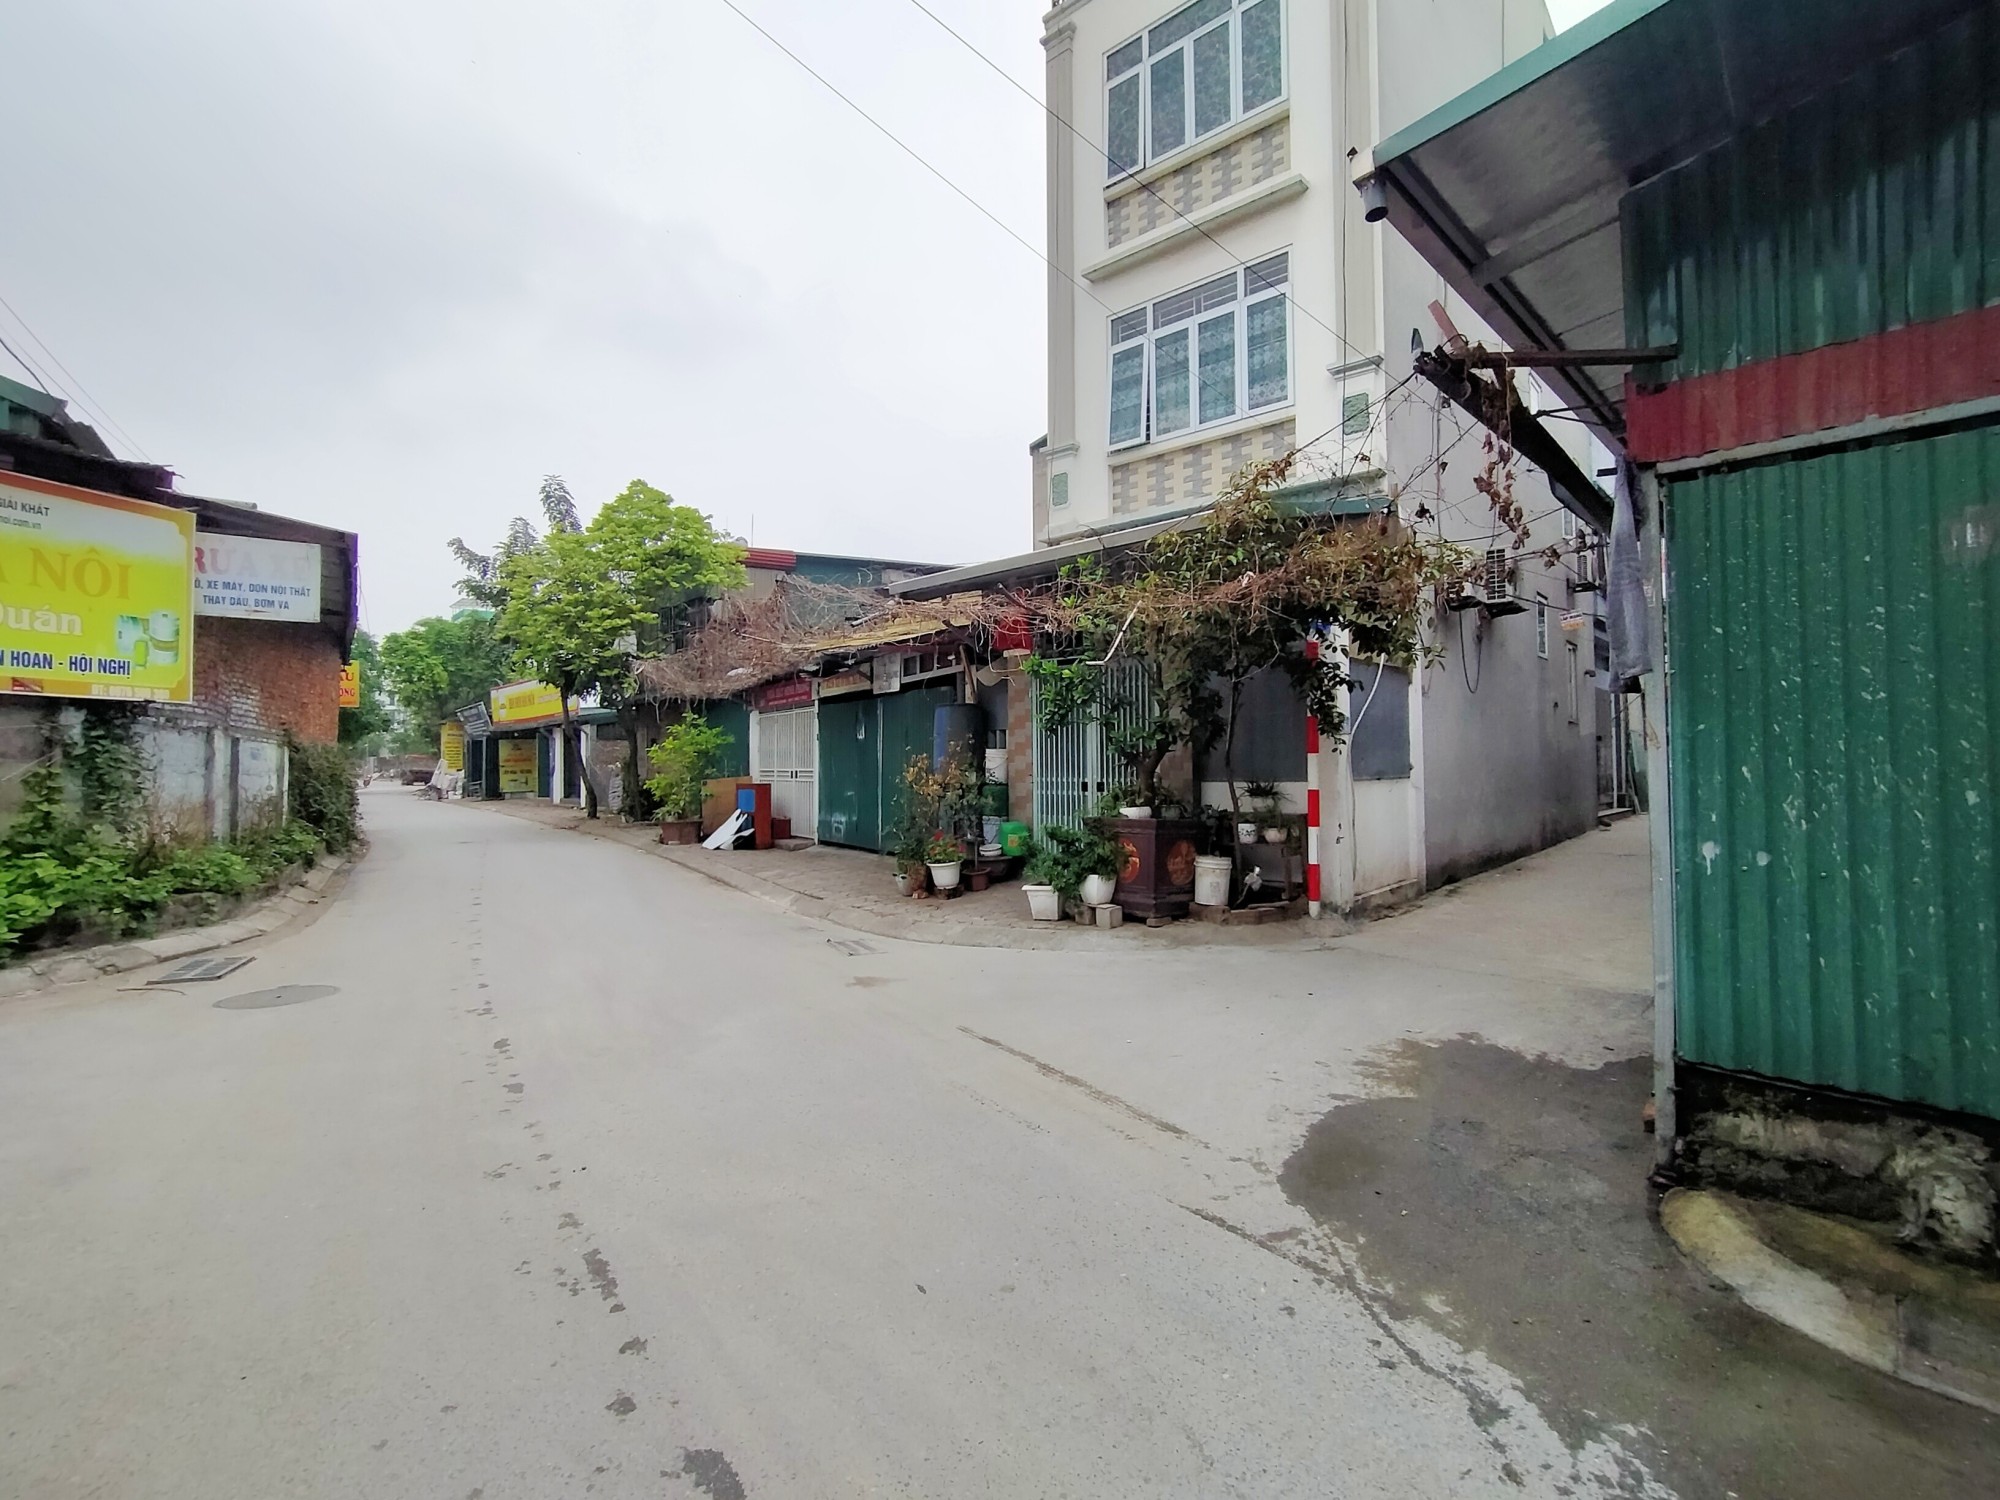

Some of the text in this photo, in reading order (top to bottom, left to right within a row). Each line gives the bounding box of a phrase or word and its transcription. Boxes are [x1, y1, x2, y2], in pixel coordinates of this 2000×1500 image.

[0, 603, 83, 637] uán
[11, 650, 53, 670] HOAN
[69, 653, 92, 676] HỘI
[98, 657, 131, 680] NGHỊ
